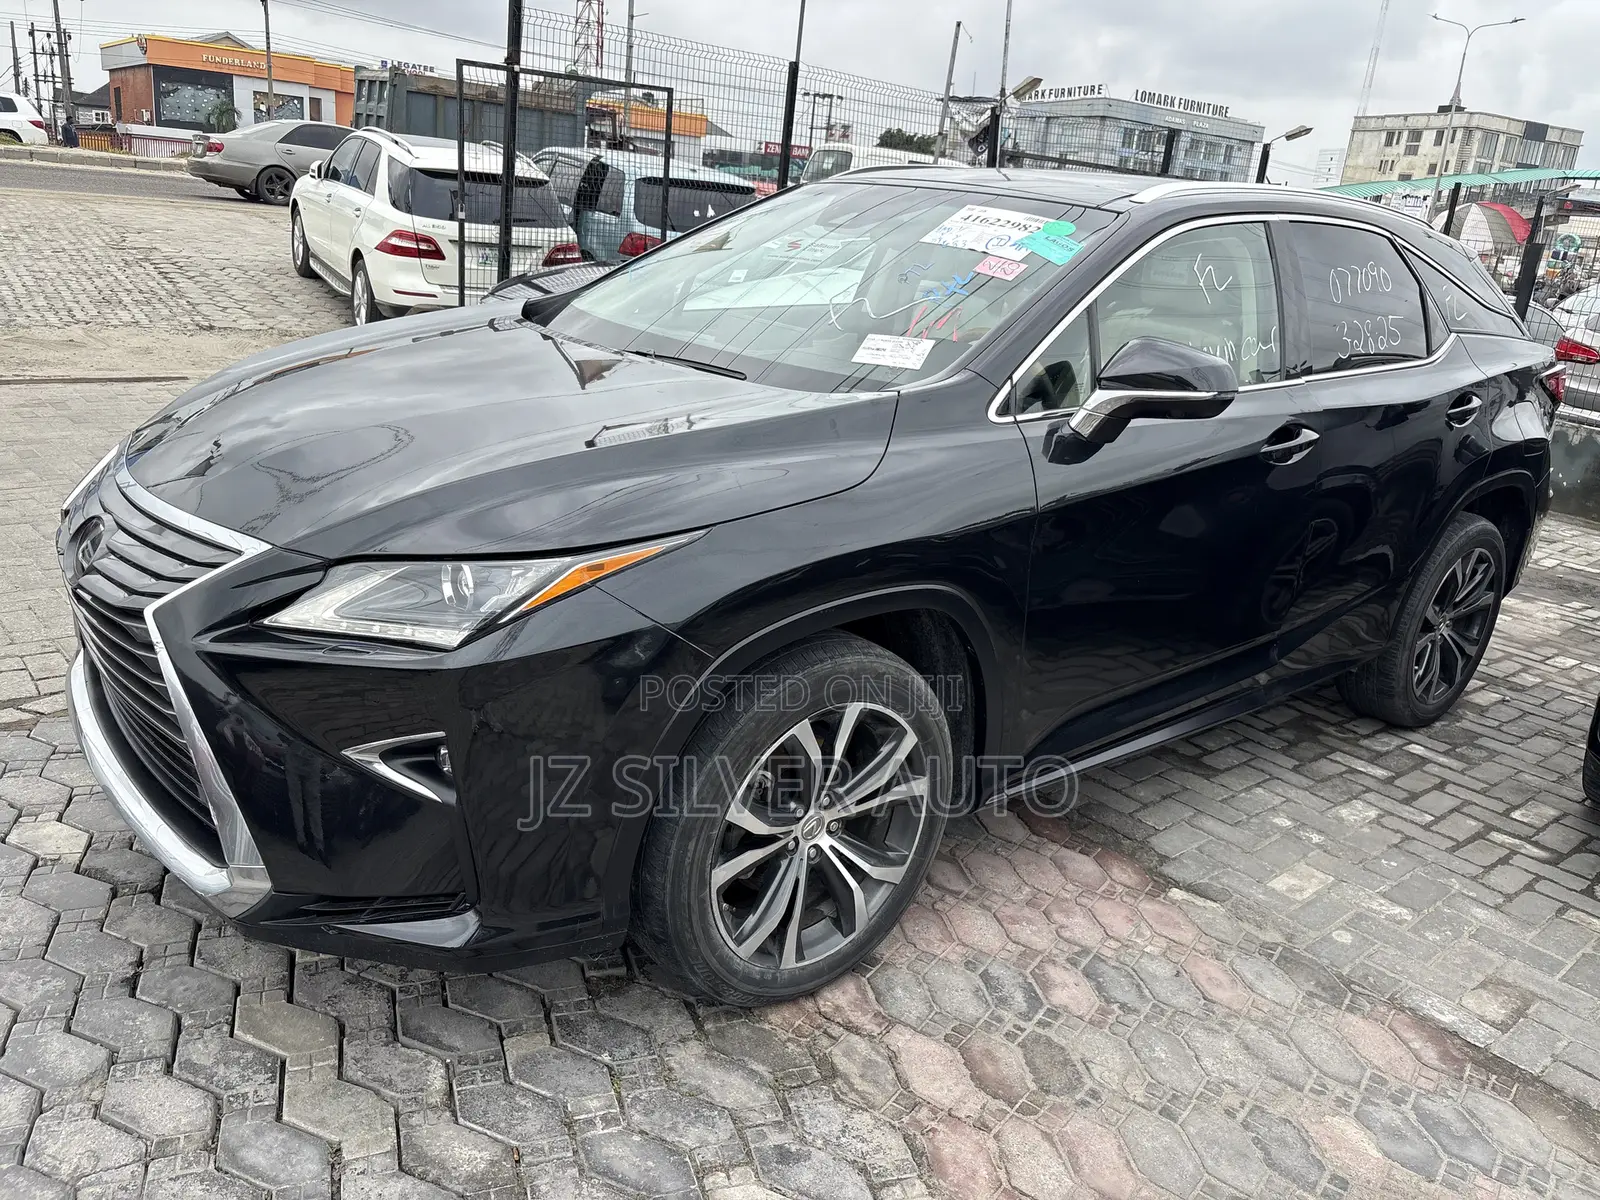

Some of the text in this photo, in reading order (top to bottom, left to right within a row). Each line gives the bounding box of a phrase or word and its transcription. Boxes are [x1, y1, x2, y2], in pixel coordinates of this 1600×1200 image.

[202, 54, 266, 70] FUNDERLAND
[391, 60, 435, 72] LEGATEE
[1048, 84, 1103, 99] FURNITURE
[1134, 89, 1230, 118] LOMARK FURNITURE
[1193, 120, 1209, 129] PLAZA
[1329, 261, 1392, 304] 077090
